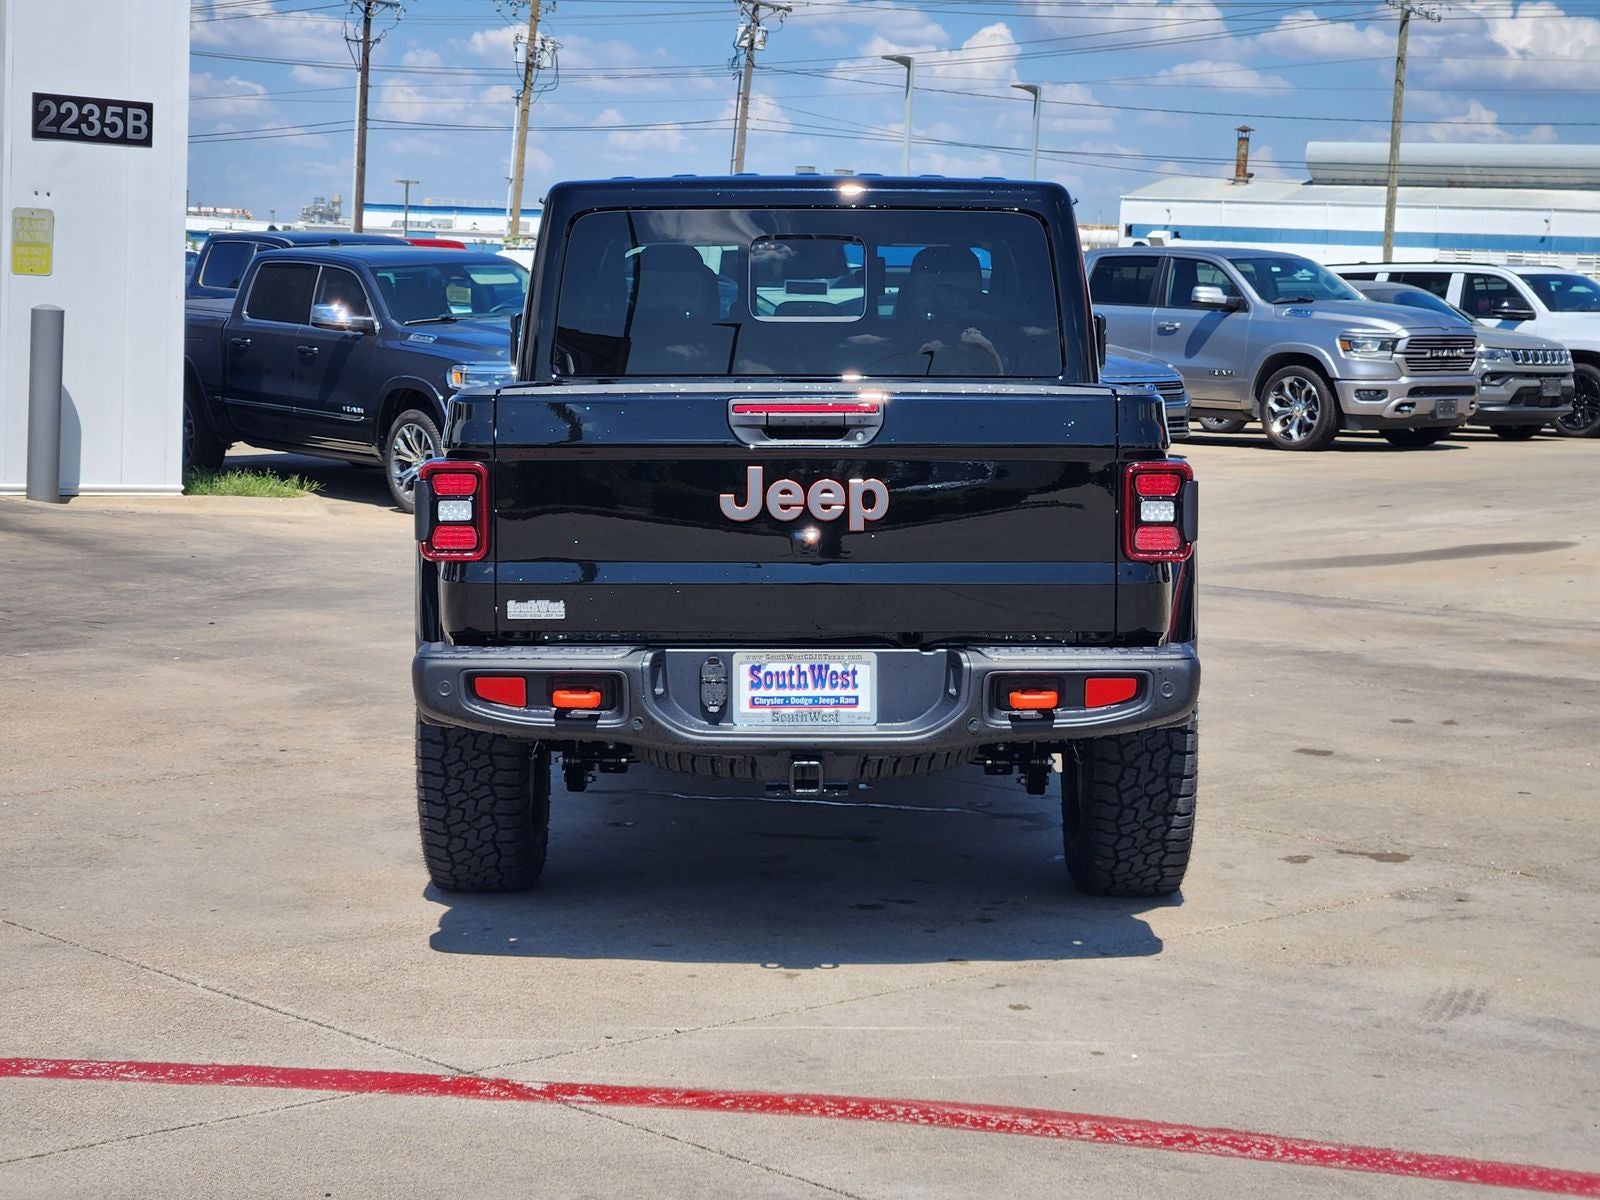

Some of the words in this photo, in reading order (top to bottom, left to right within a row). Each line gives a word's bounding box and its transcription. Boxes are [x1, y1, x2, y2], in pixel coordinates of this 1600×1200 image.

[37, 99, 149, 140] 2235B
[719, 465, 889, 532] Jeep
[750, 664, 859, 691] SouthWest
[754, 696, 784, 706] Chrysler
[790, 696, 813, 706] Dodge
[818, 696, 835, 706] Jeep
[839, 696, 856, 705] Ram
[771, 711, 840, 723] SouthWest
